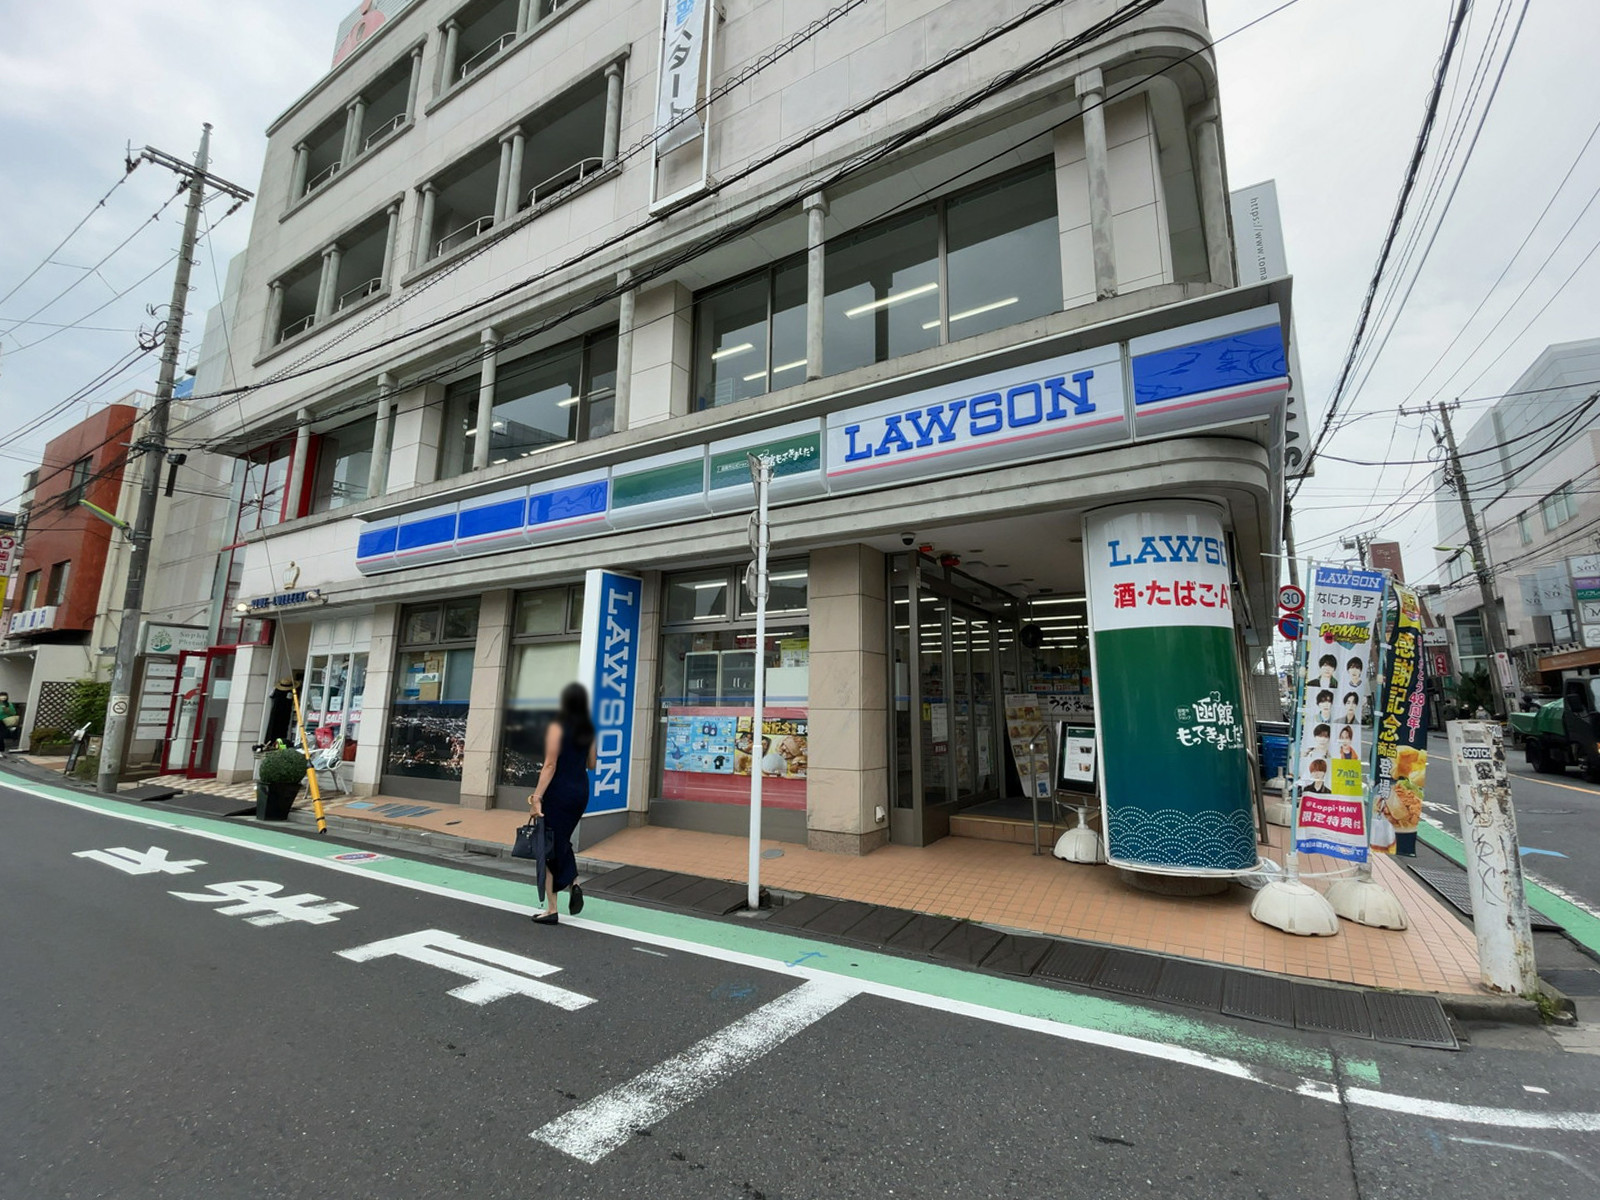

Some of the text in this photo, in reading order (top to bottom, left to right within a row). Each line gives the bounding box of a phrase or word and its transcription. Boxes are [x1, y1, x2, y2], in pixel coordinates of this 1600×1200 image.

[845, 371, 1096, 462] LAWSON
[1317, 571, 1382, 589] LAWSON
[1113, 579, 1231, 610] 酒・たばこ・A
[1283, 592, 1300, 605] 30
[1317, 592, 1375, 609] なにわ男子
[1322, 609, 1367, 621] 2nd Album
[594, 588, 633, 795] LAWSON
[1192, 696, 1235, 725] 函館
